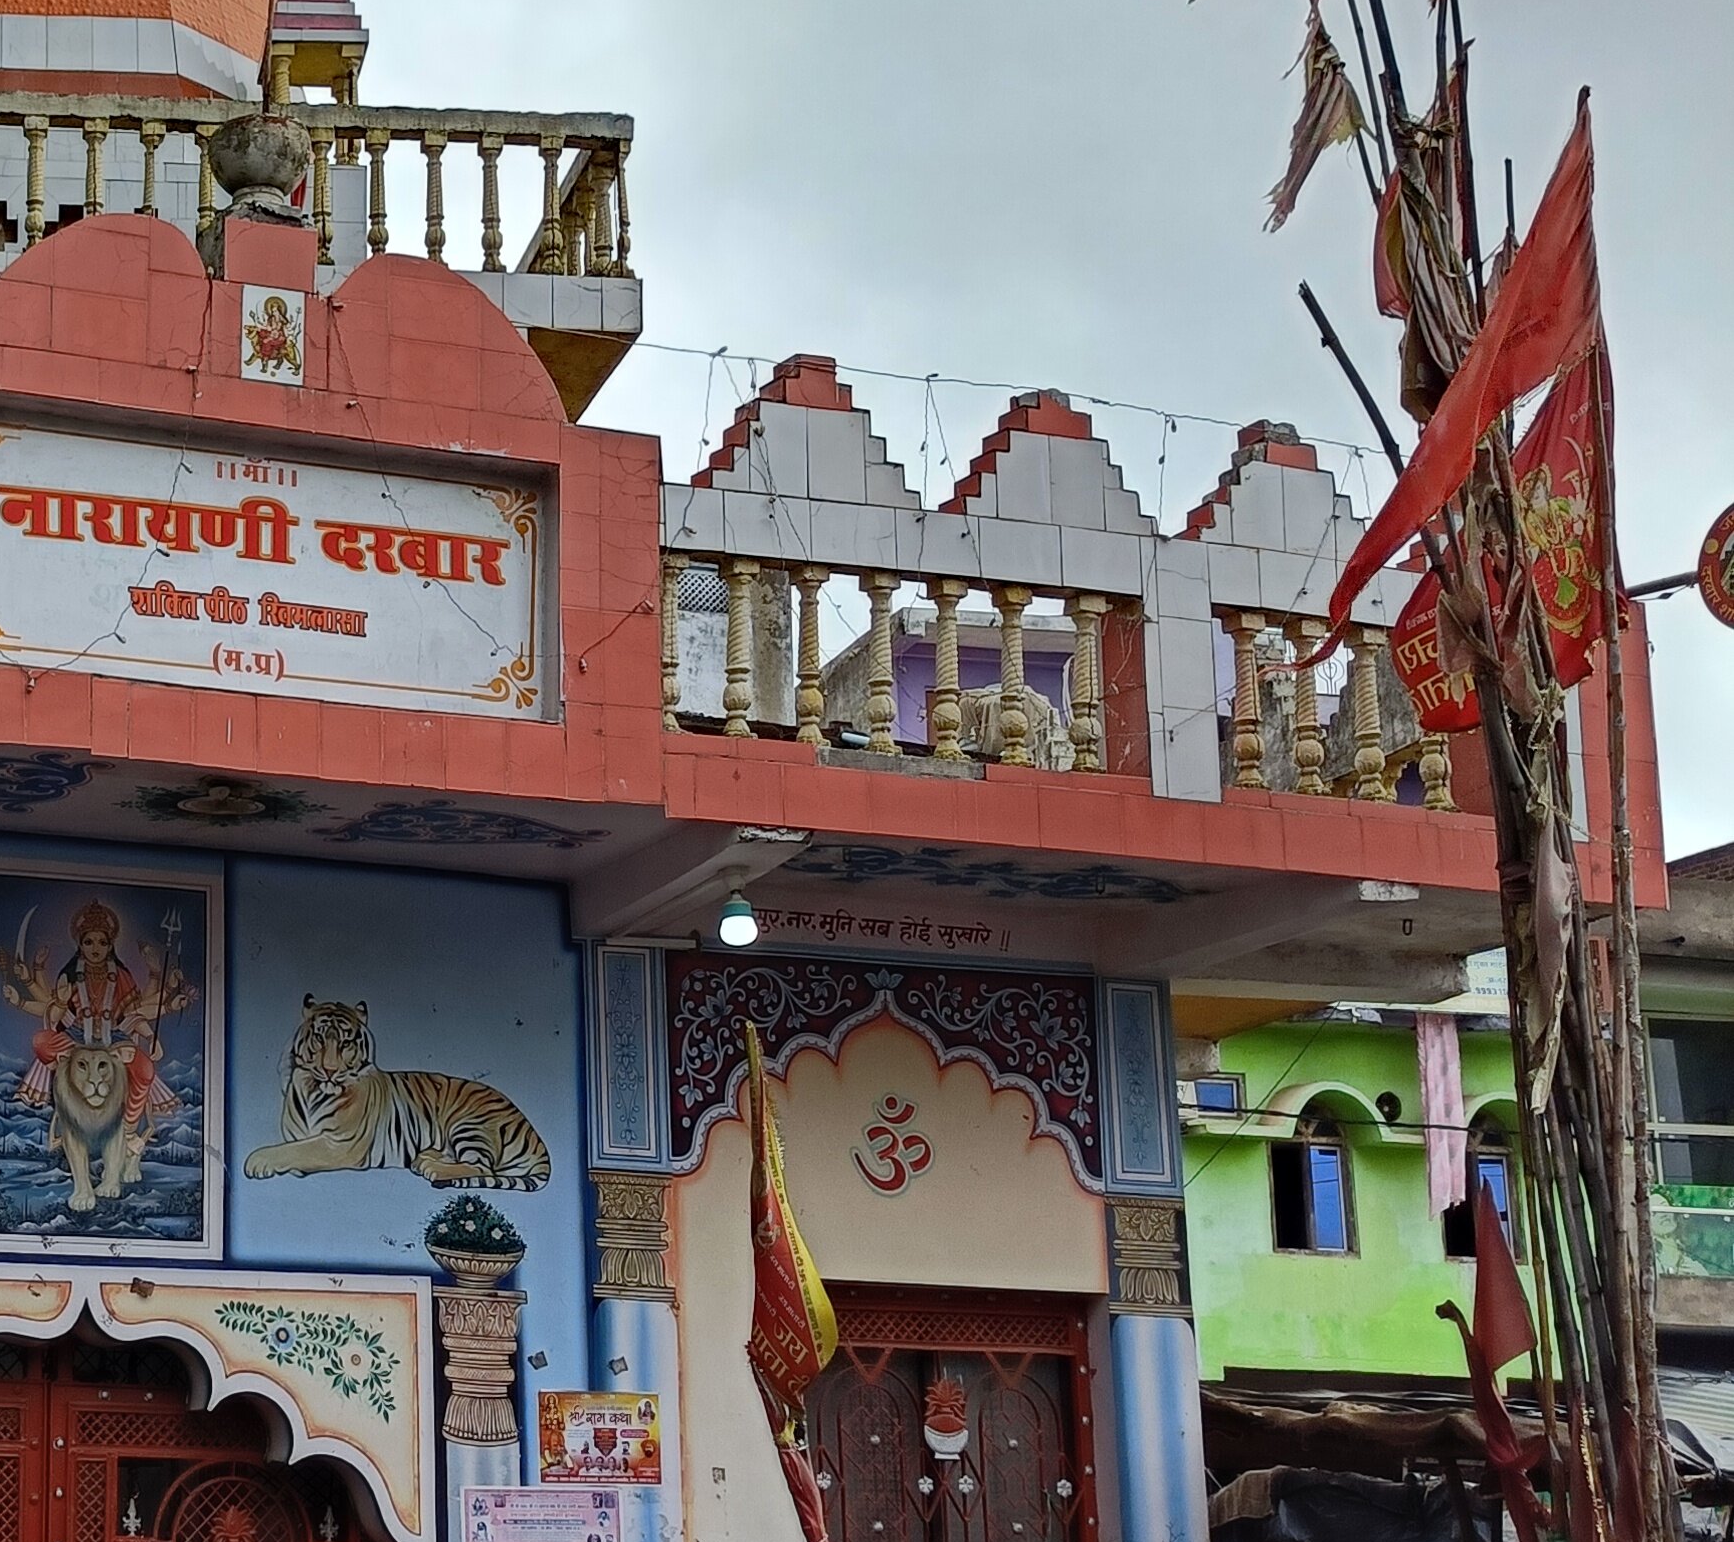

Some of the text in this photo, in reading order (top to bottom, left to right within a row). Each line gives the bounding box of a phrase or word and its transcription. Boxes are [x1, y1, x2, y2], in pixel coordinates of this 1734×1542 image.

[314, 519, 510, 585] दरबार
[128, 580, 368, 636] शक्ति पीठ खिमलासा
[859, 918, 894, 938] सब
[899, 916, 933, 946] होई
[938, 921, 992, 949] सुखारे
[586, 1412, 605, 1425] राम
[609, 1412, 632, 1425] कथा
